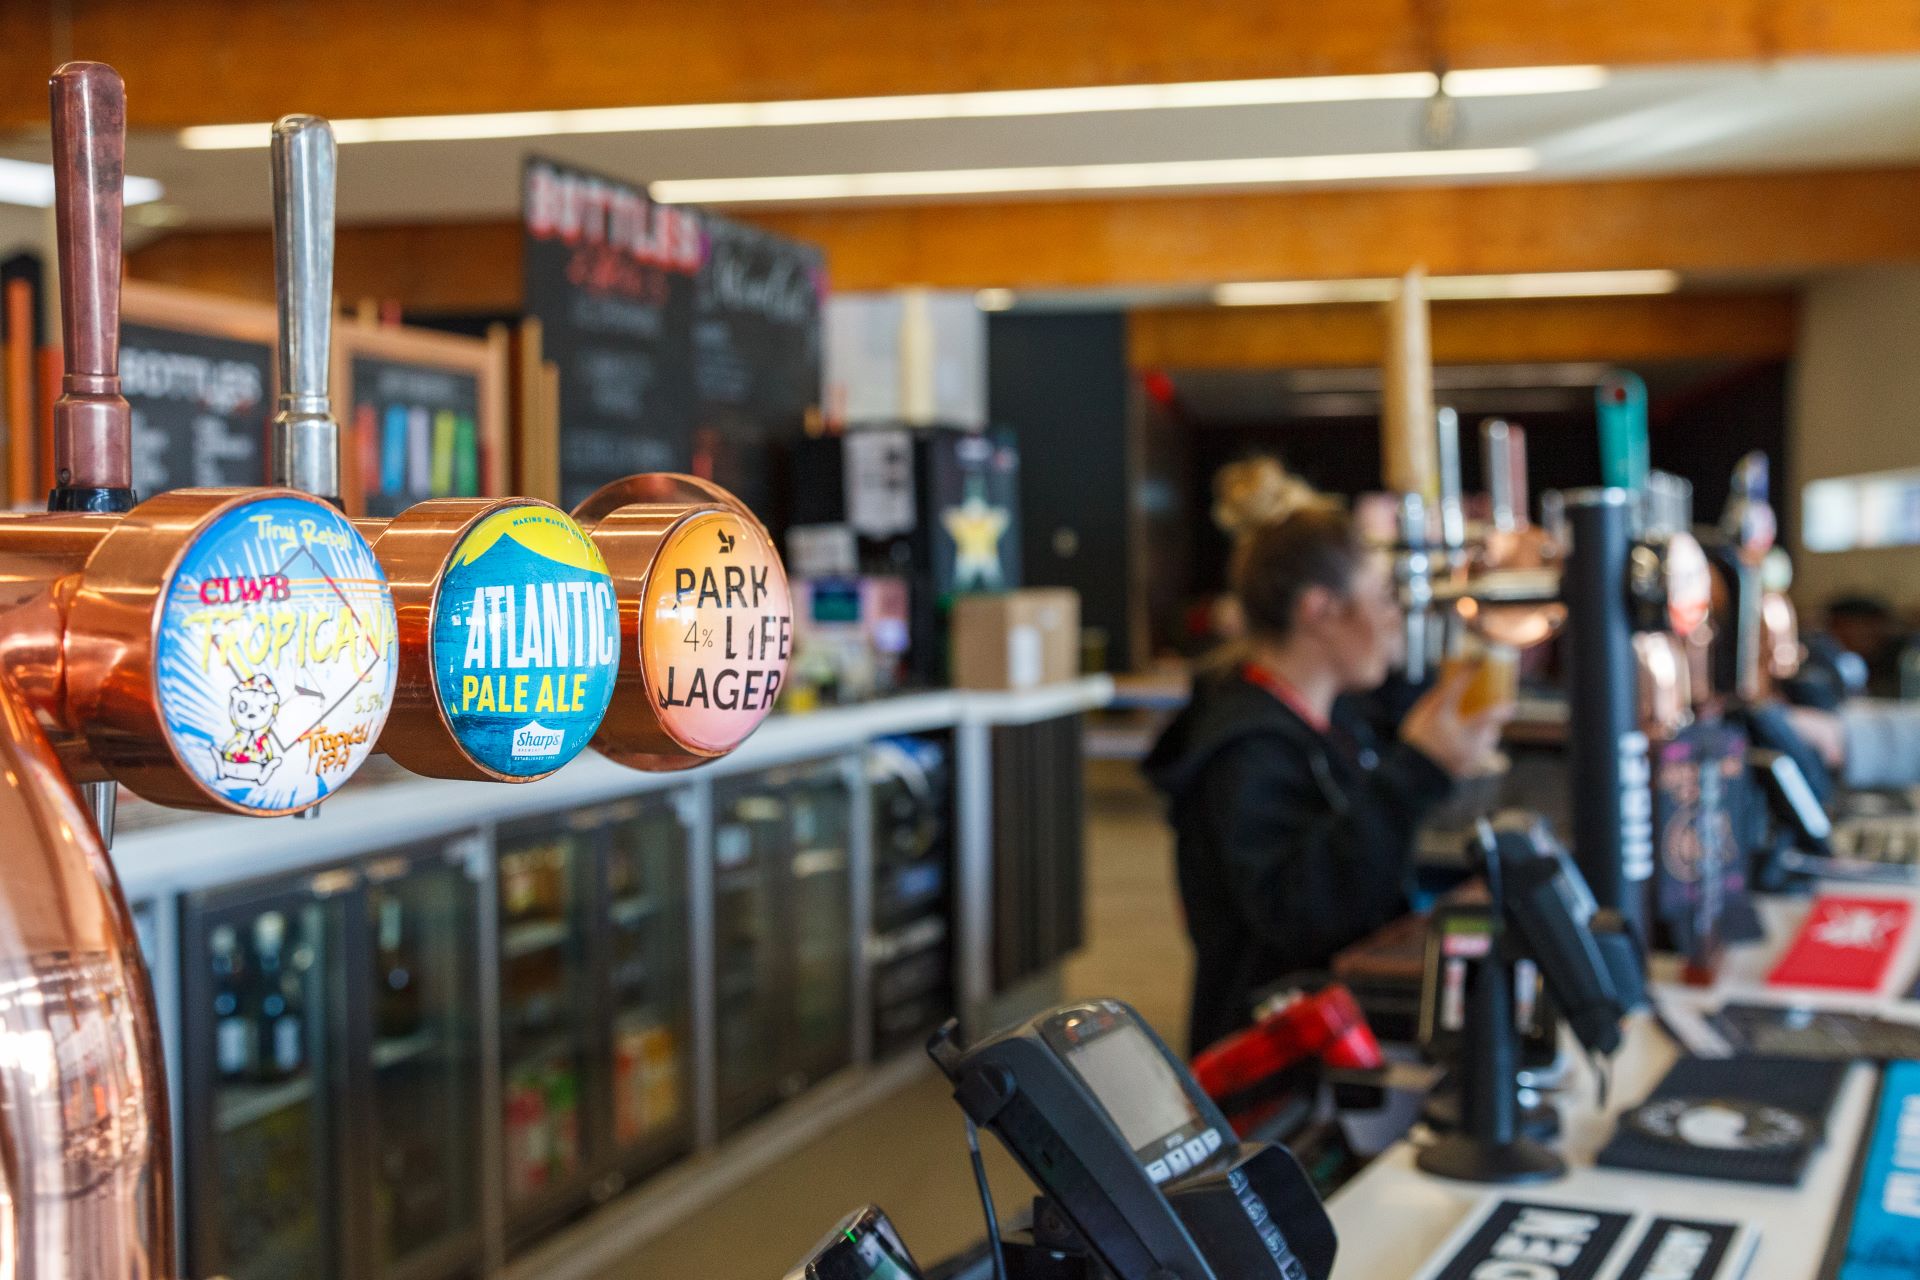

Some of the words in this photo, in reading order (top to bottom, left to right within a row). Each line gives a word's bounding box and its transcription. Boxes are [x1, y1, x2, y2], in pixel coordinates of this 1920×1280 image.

[249, 514, 299, 558] Tiny
[512, 516, 543, 527] MAKING
[199, 574, 291, 605] CLWB
[673, 565, 768, 609] PARK
[463, 581, 614, 669] ATLANTIC
[683, 620, 714, 653] 4%
[725, 615, 791, 661] LIFE
[462, 674, 530, 713] PALE
[534, 673, 588, 713] ALE
[659, 666, 782, 711] LAGER
[316, 749, 351, 775] IPA
